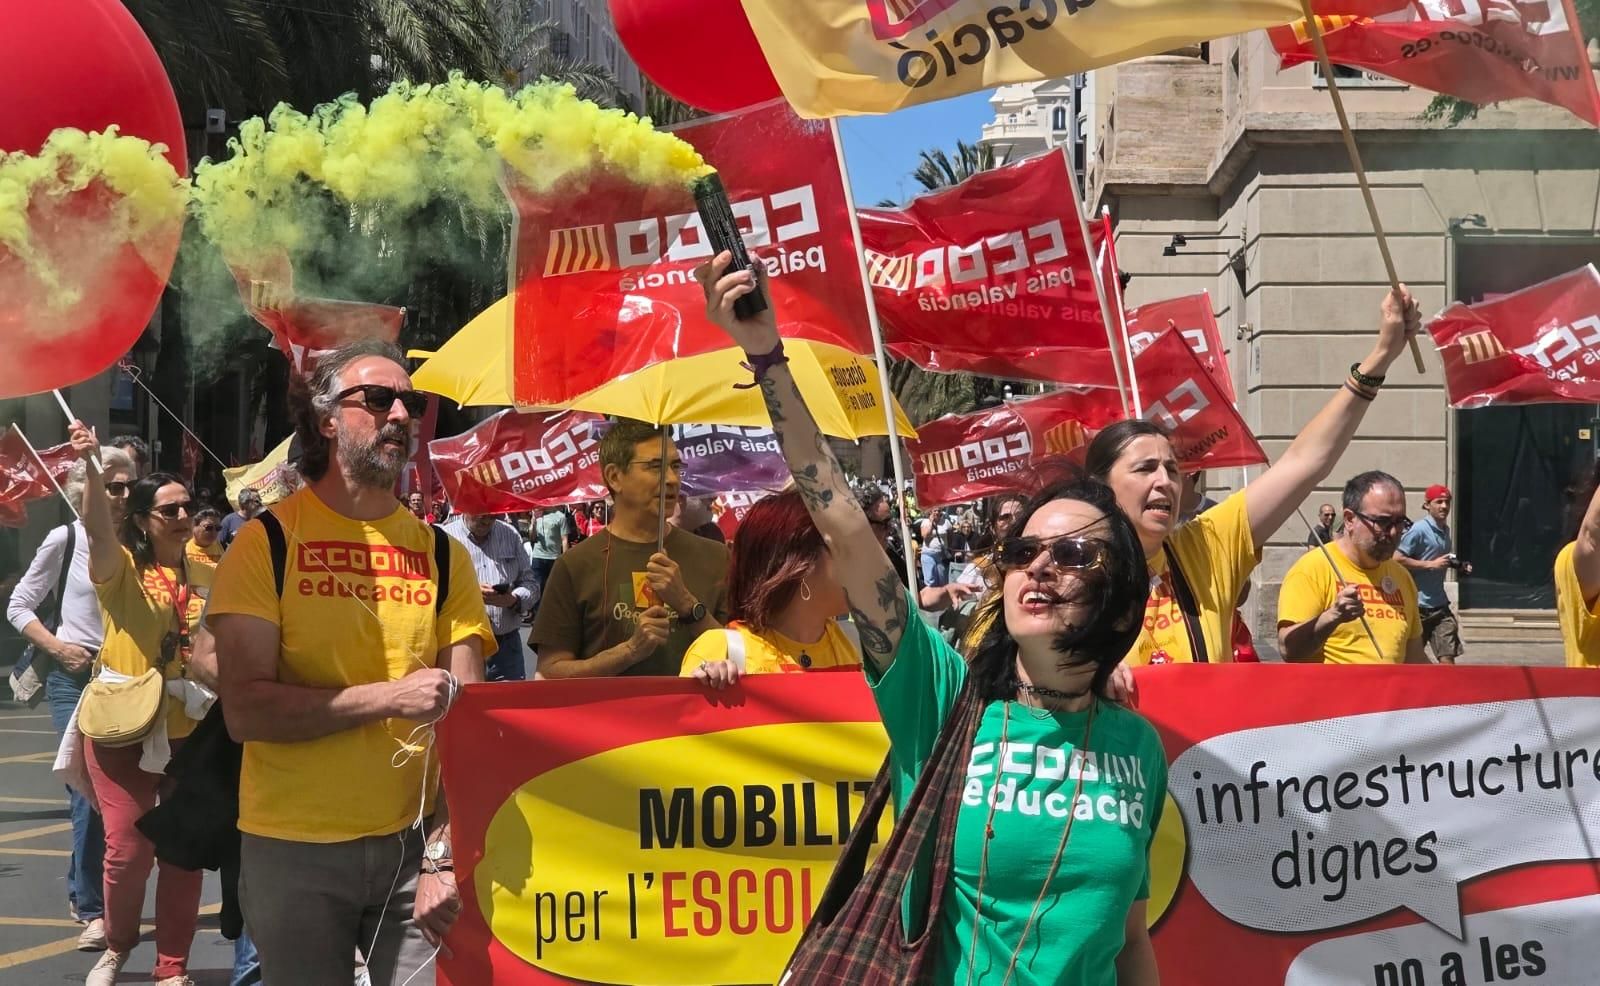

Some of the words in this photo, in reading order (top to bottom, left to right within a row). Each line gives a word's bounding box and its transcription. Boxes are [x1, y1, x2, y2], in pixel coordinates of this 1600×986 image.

[303, 548, 390, 571] CCOO
[298, 575, 433, 606] educació
[967, 742, 1099, 782] CCOO
[963, 777, 1144, 830] educació
[1271, 830, 1438, 902] dignes
[535, 887, 609, 960] per
[1440, 951, 1467, 986] a
[1479, 936, 1547, 982] les
